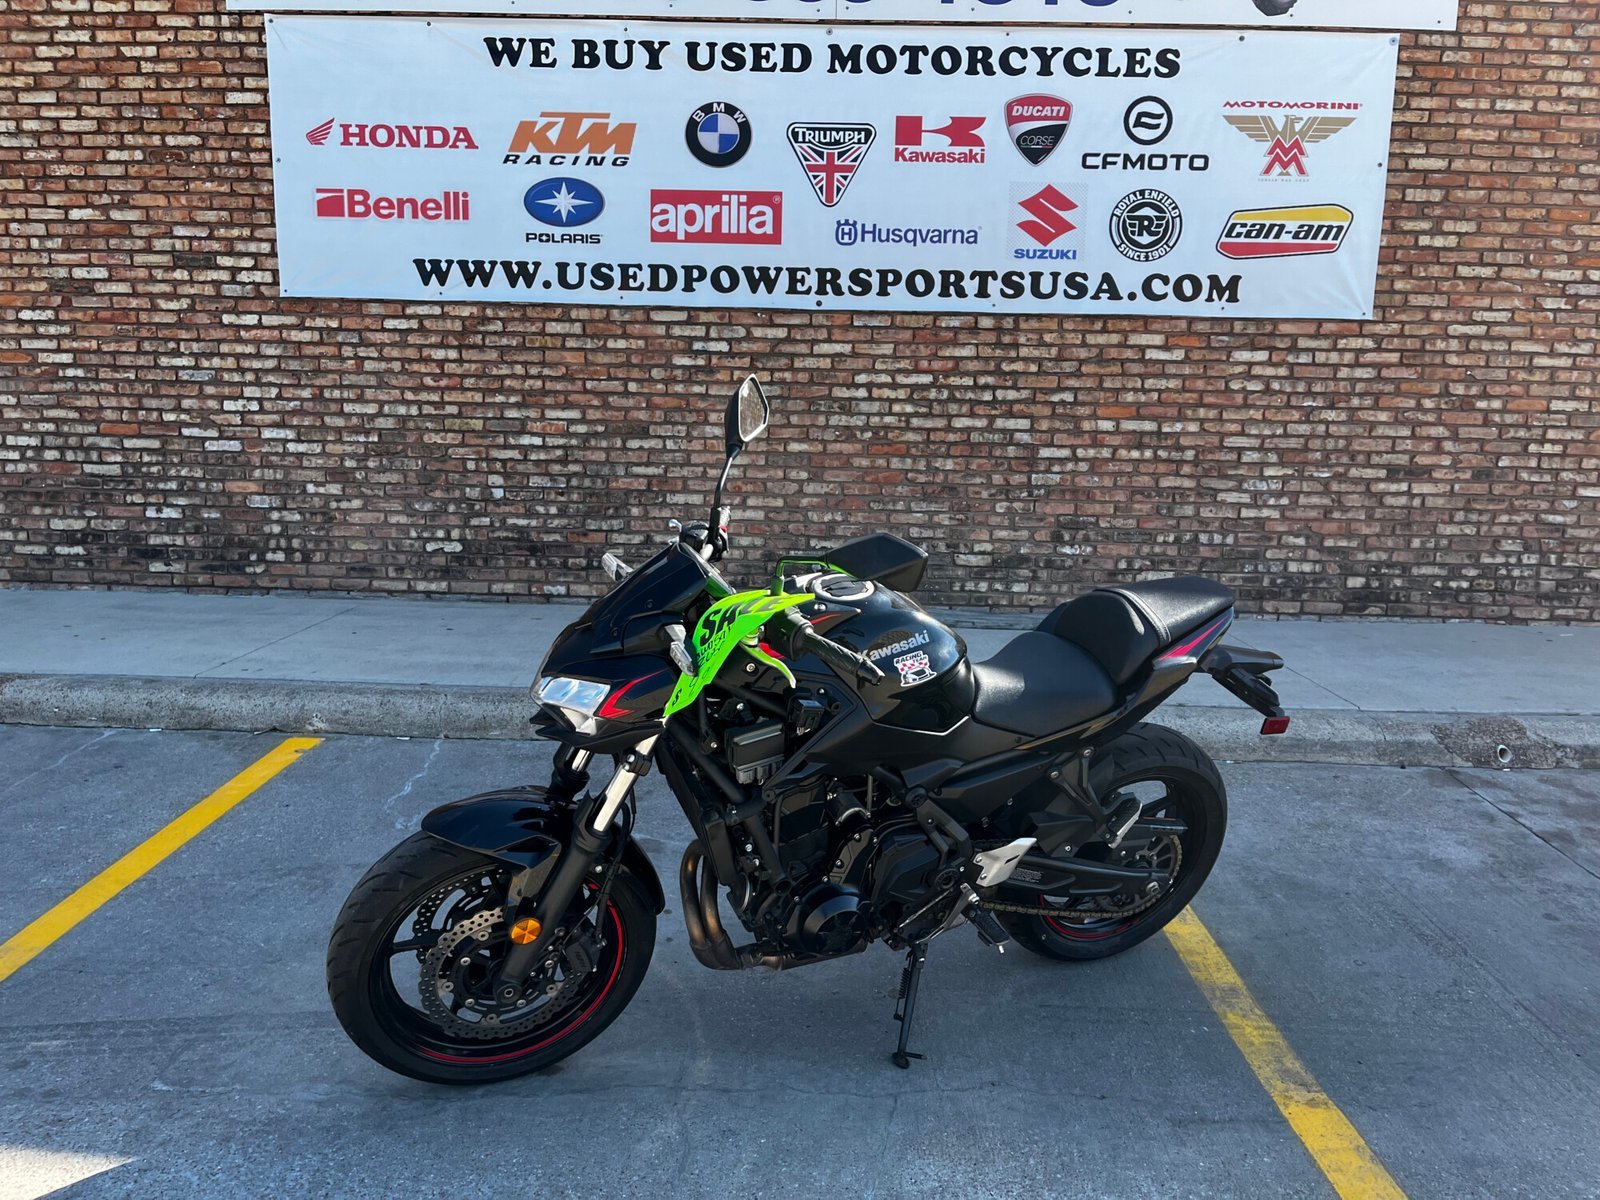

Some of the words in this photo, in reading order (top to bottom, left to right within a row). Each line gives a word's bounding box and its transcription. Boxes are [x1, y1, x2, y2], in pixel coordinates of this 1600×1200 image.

[482, 37, 558, 68] WE
[571, 39, 671, 70] BUY
[685, 42, 813, 73] USED
[827, 43, 1181, 78] MOTORCYCLES
[692, 102, 746, 124] BMW
[1012, 105, 1066, 117] DUCATI
[1223, 100, 1359, 110] MOTOMORINI
[339, 123, 479, 150] HONDA
[508, 111, 637, 154] KTM
[795, 127, 866, 144] TRIUMPH
[1020, 135, 1055, 146] CORSE
[502, 154, 630, 167] RACING
[895, 147, 986, 164] Kawasaki
[1081, 152, 1210, 171] CFMOTO
[346, 188, 470, 221] Benelli
[1113, 191, 1143, 217] ROYAL
[1144, 190, 1180, 218] ENFIELD
[651, 194, 774, 240] aprilia
[526, 232, 601, 244] POLARIS
[861, 223, 978, 247] Husqvarna
[1224, 222, 1345, 241] can-am
[1013, 248, 1077, 260] SUZUKI
[1118, 243, 1147, 260] SINCE
[1147, 244, 1171, 260] 1901
[413, 258, 1240, 303] WWW.USEDPOWERSPORTSUSA.COM
[895, 652, 922, 664] RACING
